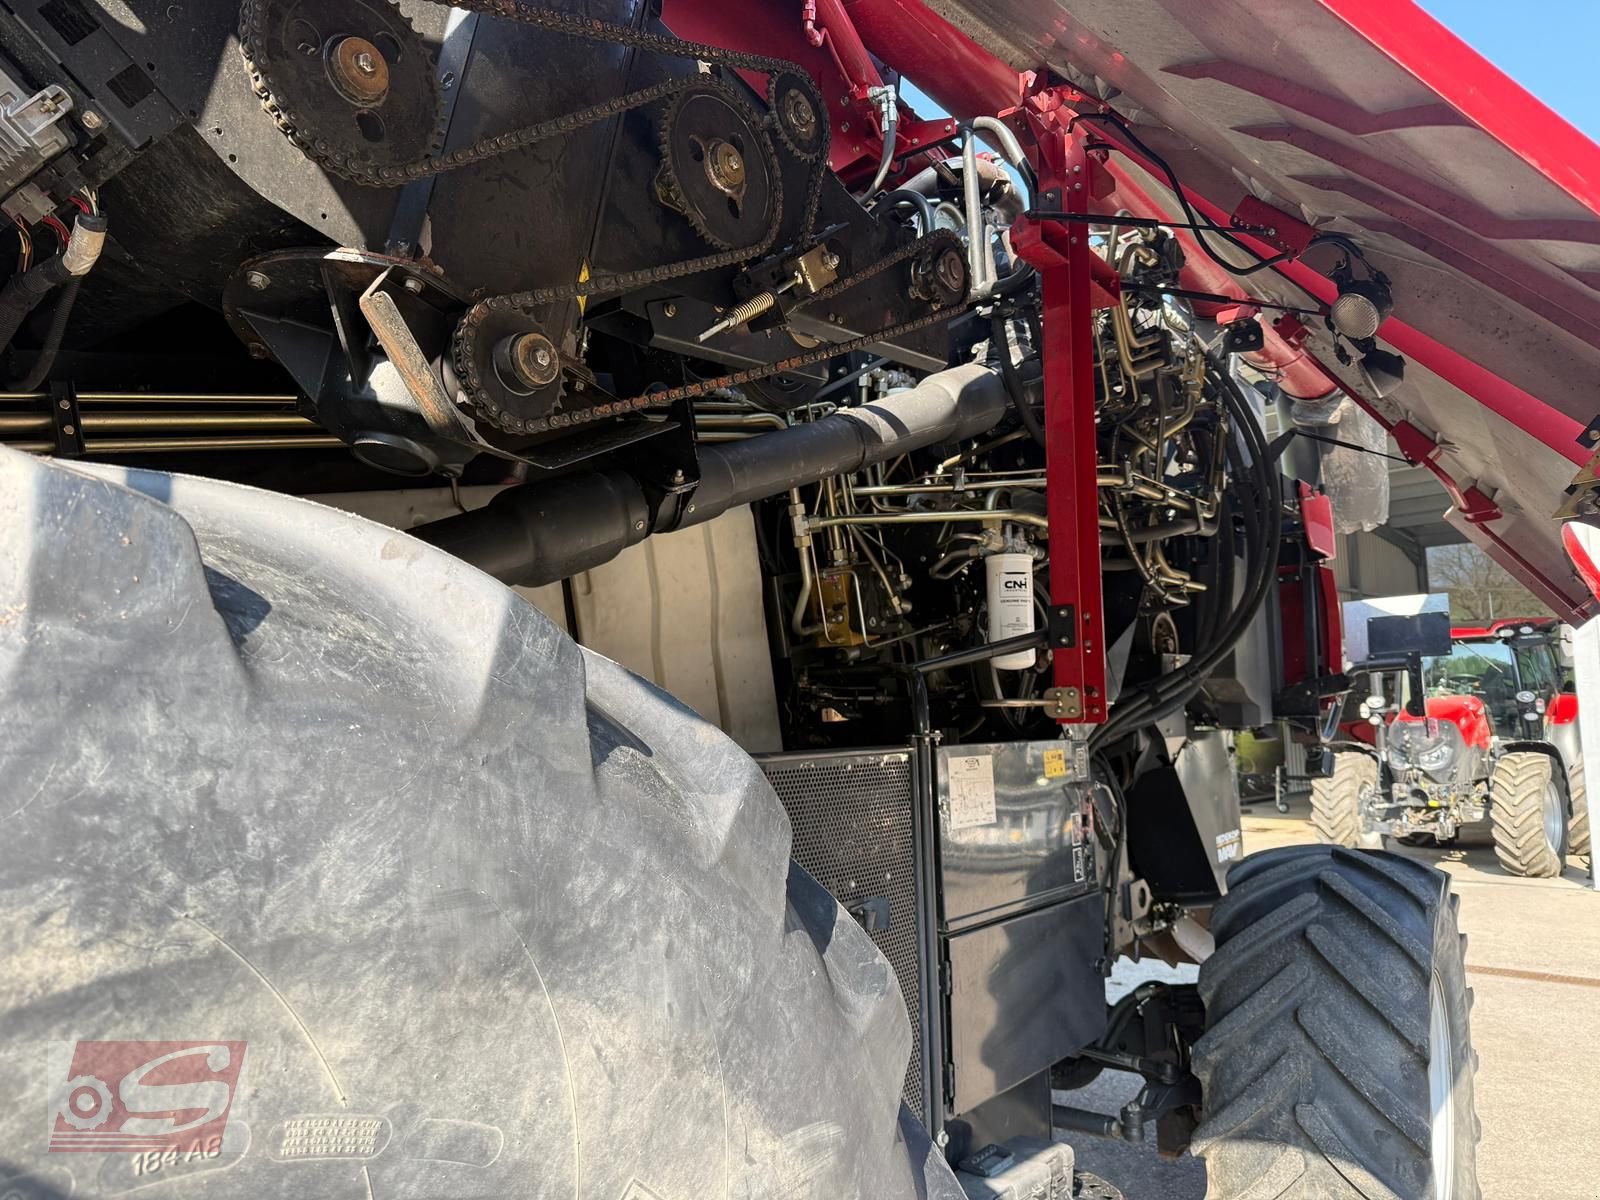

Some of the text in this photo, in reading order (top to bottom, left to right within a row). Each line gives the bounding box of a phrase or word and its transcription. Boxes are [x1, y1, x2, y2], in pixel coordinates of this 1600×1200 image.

[306, 1119, 331, 1128] LOAD
[332, 1119, 345, 1127] AT
[305, 1138, 330, 1146] LOAD
[131, 1136, 223, 1176] 184 A8
